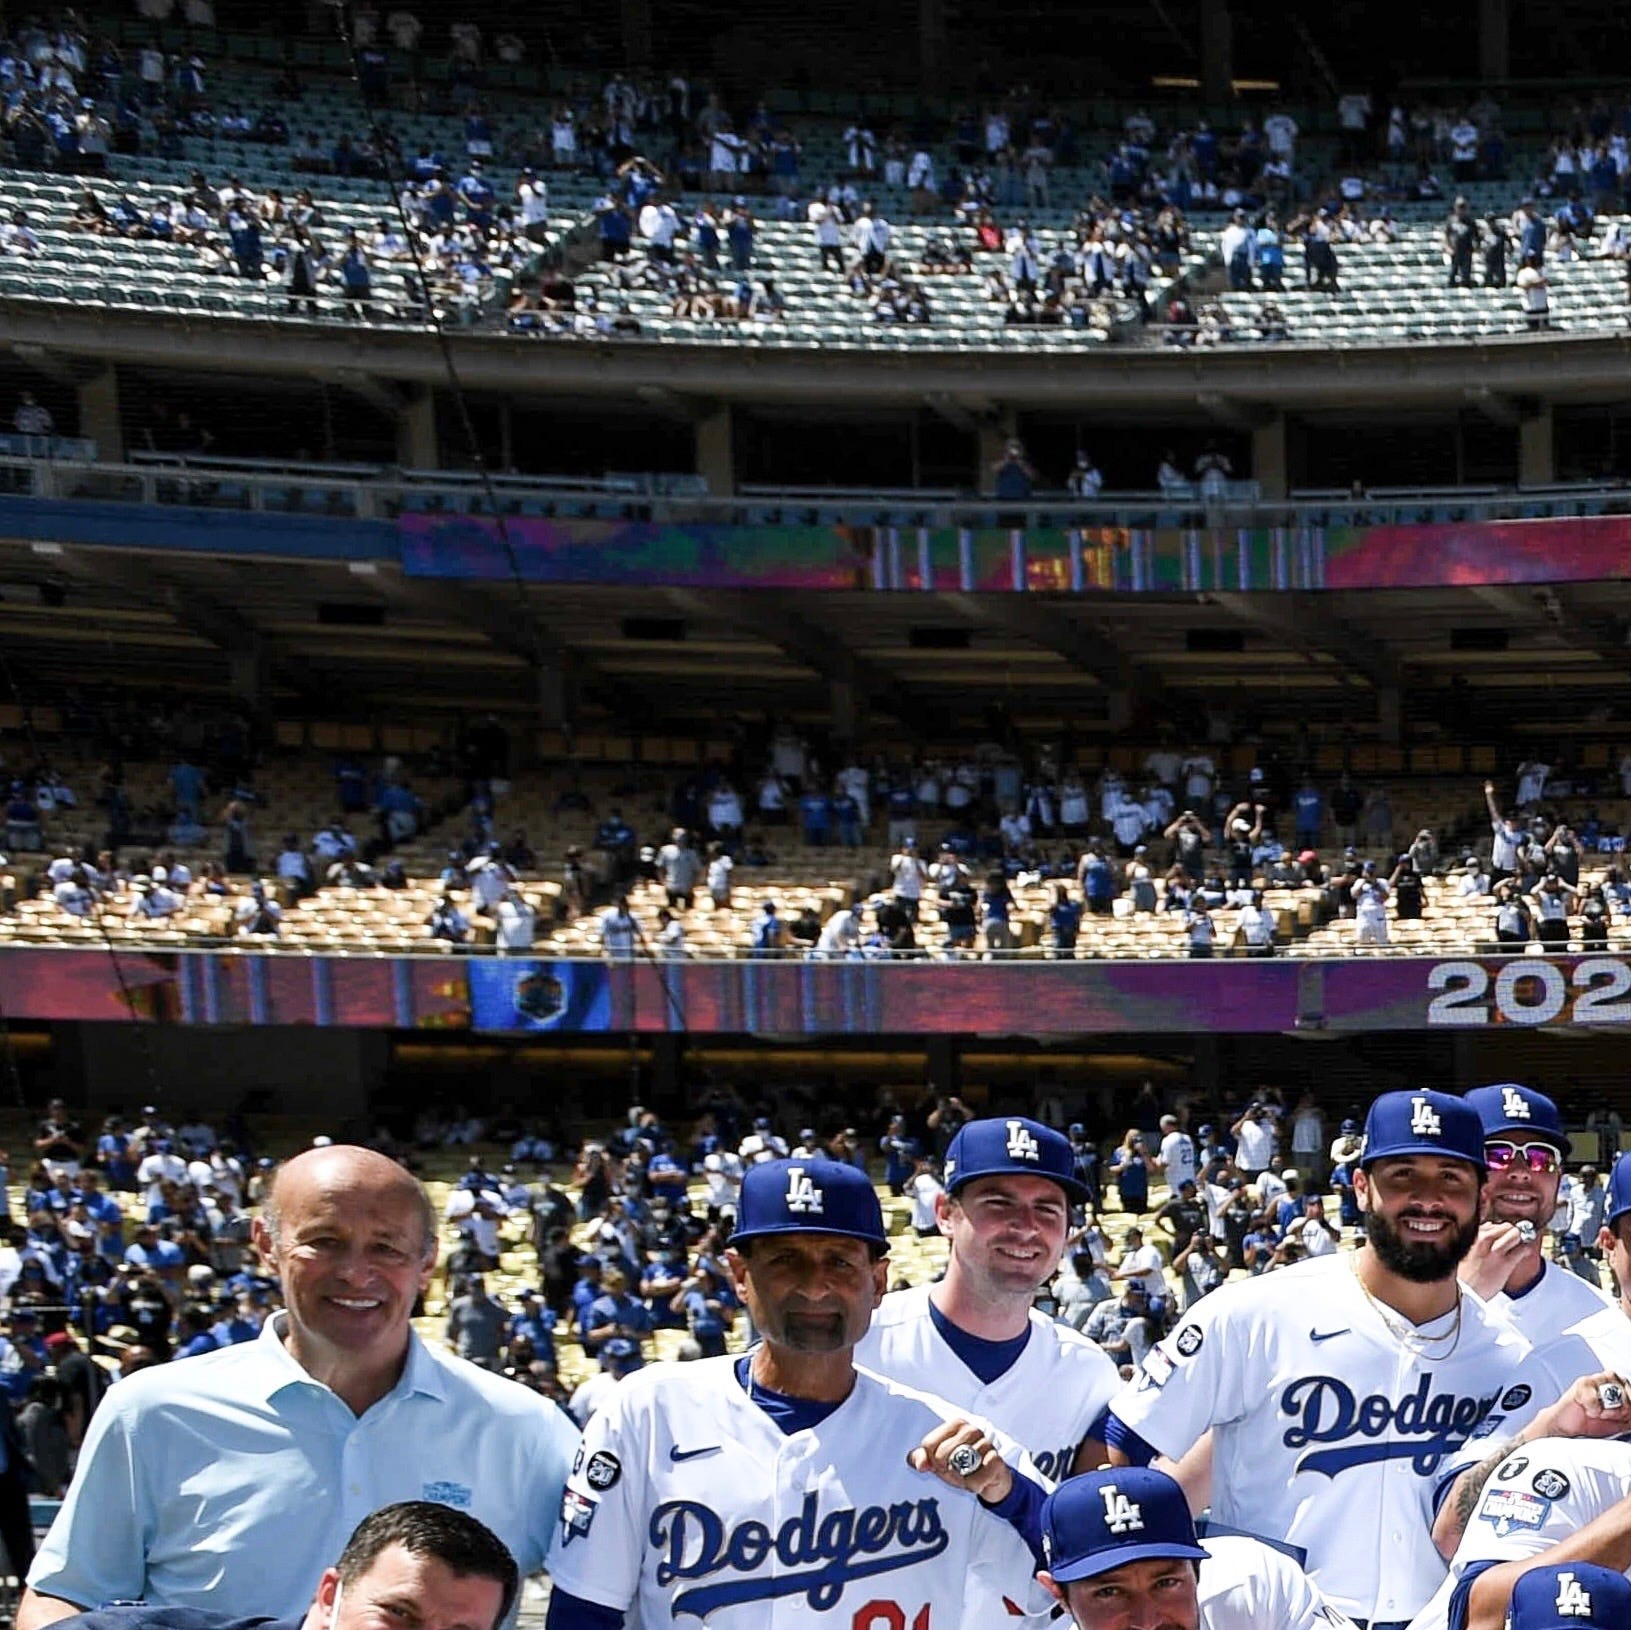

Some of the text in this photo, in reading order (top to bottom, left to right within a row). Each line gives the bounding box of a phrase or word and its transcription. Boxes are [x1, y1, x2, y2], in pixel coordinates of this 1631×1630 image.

[1411, 1098, 1440, 1134] LA
[1502, 1088, 1530, 1117] LA
[1006, 1121, 1038, 1159] LA
[786, 1168, 822, 1211] LA
[1099, 1485, 1143, 1532] LA
[656, 1490, 949, 1618] Dodgers
[1556, 1573, 1590, 1615] LA
